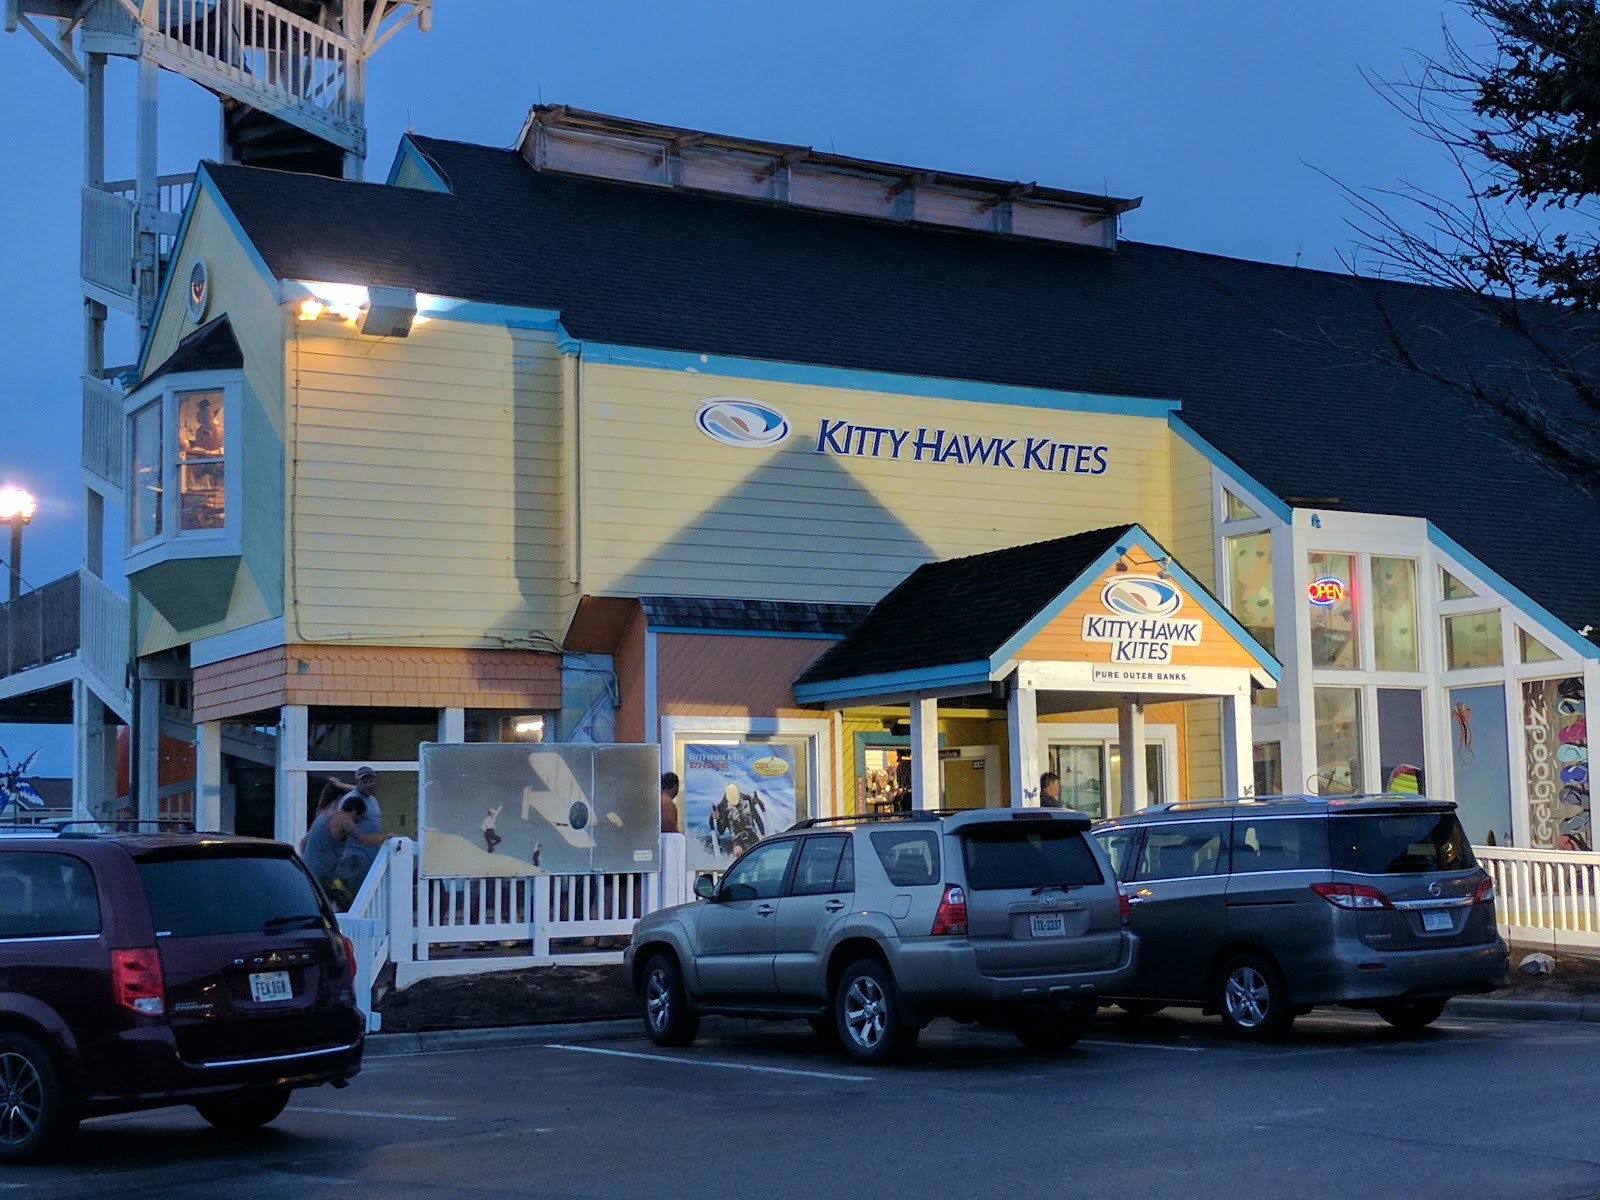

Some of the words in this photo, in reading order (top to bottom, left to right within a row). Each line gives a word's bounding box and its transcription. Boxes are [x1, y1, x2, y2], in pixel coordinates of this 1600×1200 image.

[816, 418, 911, 459] KITTY
[911, 428, 1018, 468] HAWK
[1022, 437, 1109, 475] KITES
[1308, 583, 1344, 599] OPEN
[1087, 617, 1138, 638] KITTY
[1139, 620, 1198, 641] HAWK
[1115, 641, 1169, 661] KITES
[1095, 671, 1119, 679] PURE
[1123, 672, 1153, 680] OUTER
[1157, 673, 1186, 681] BANKS
